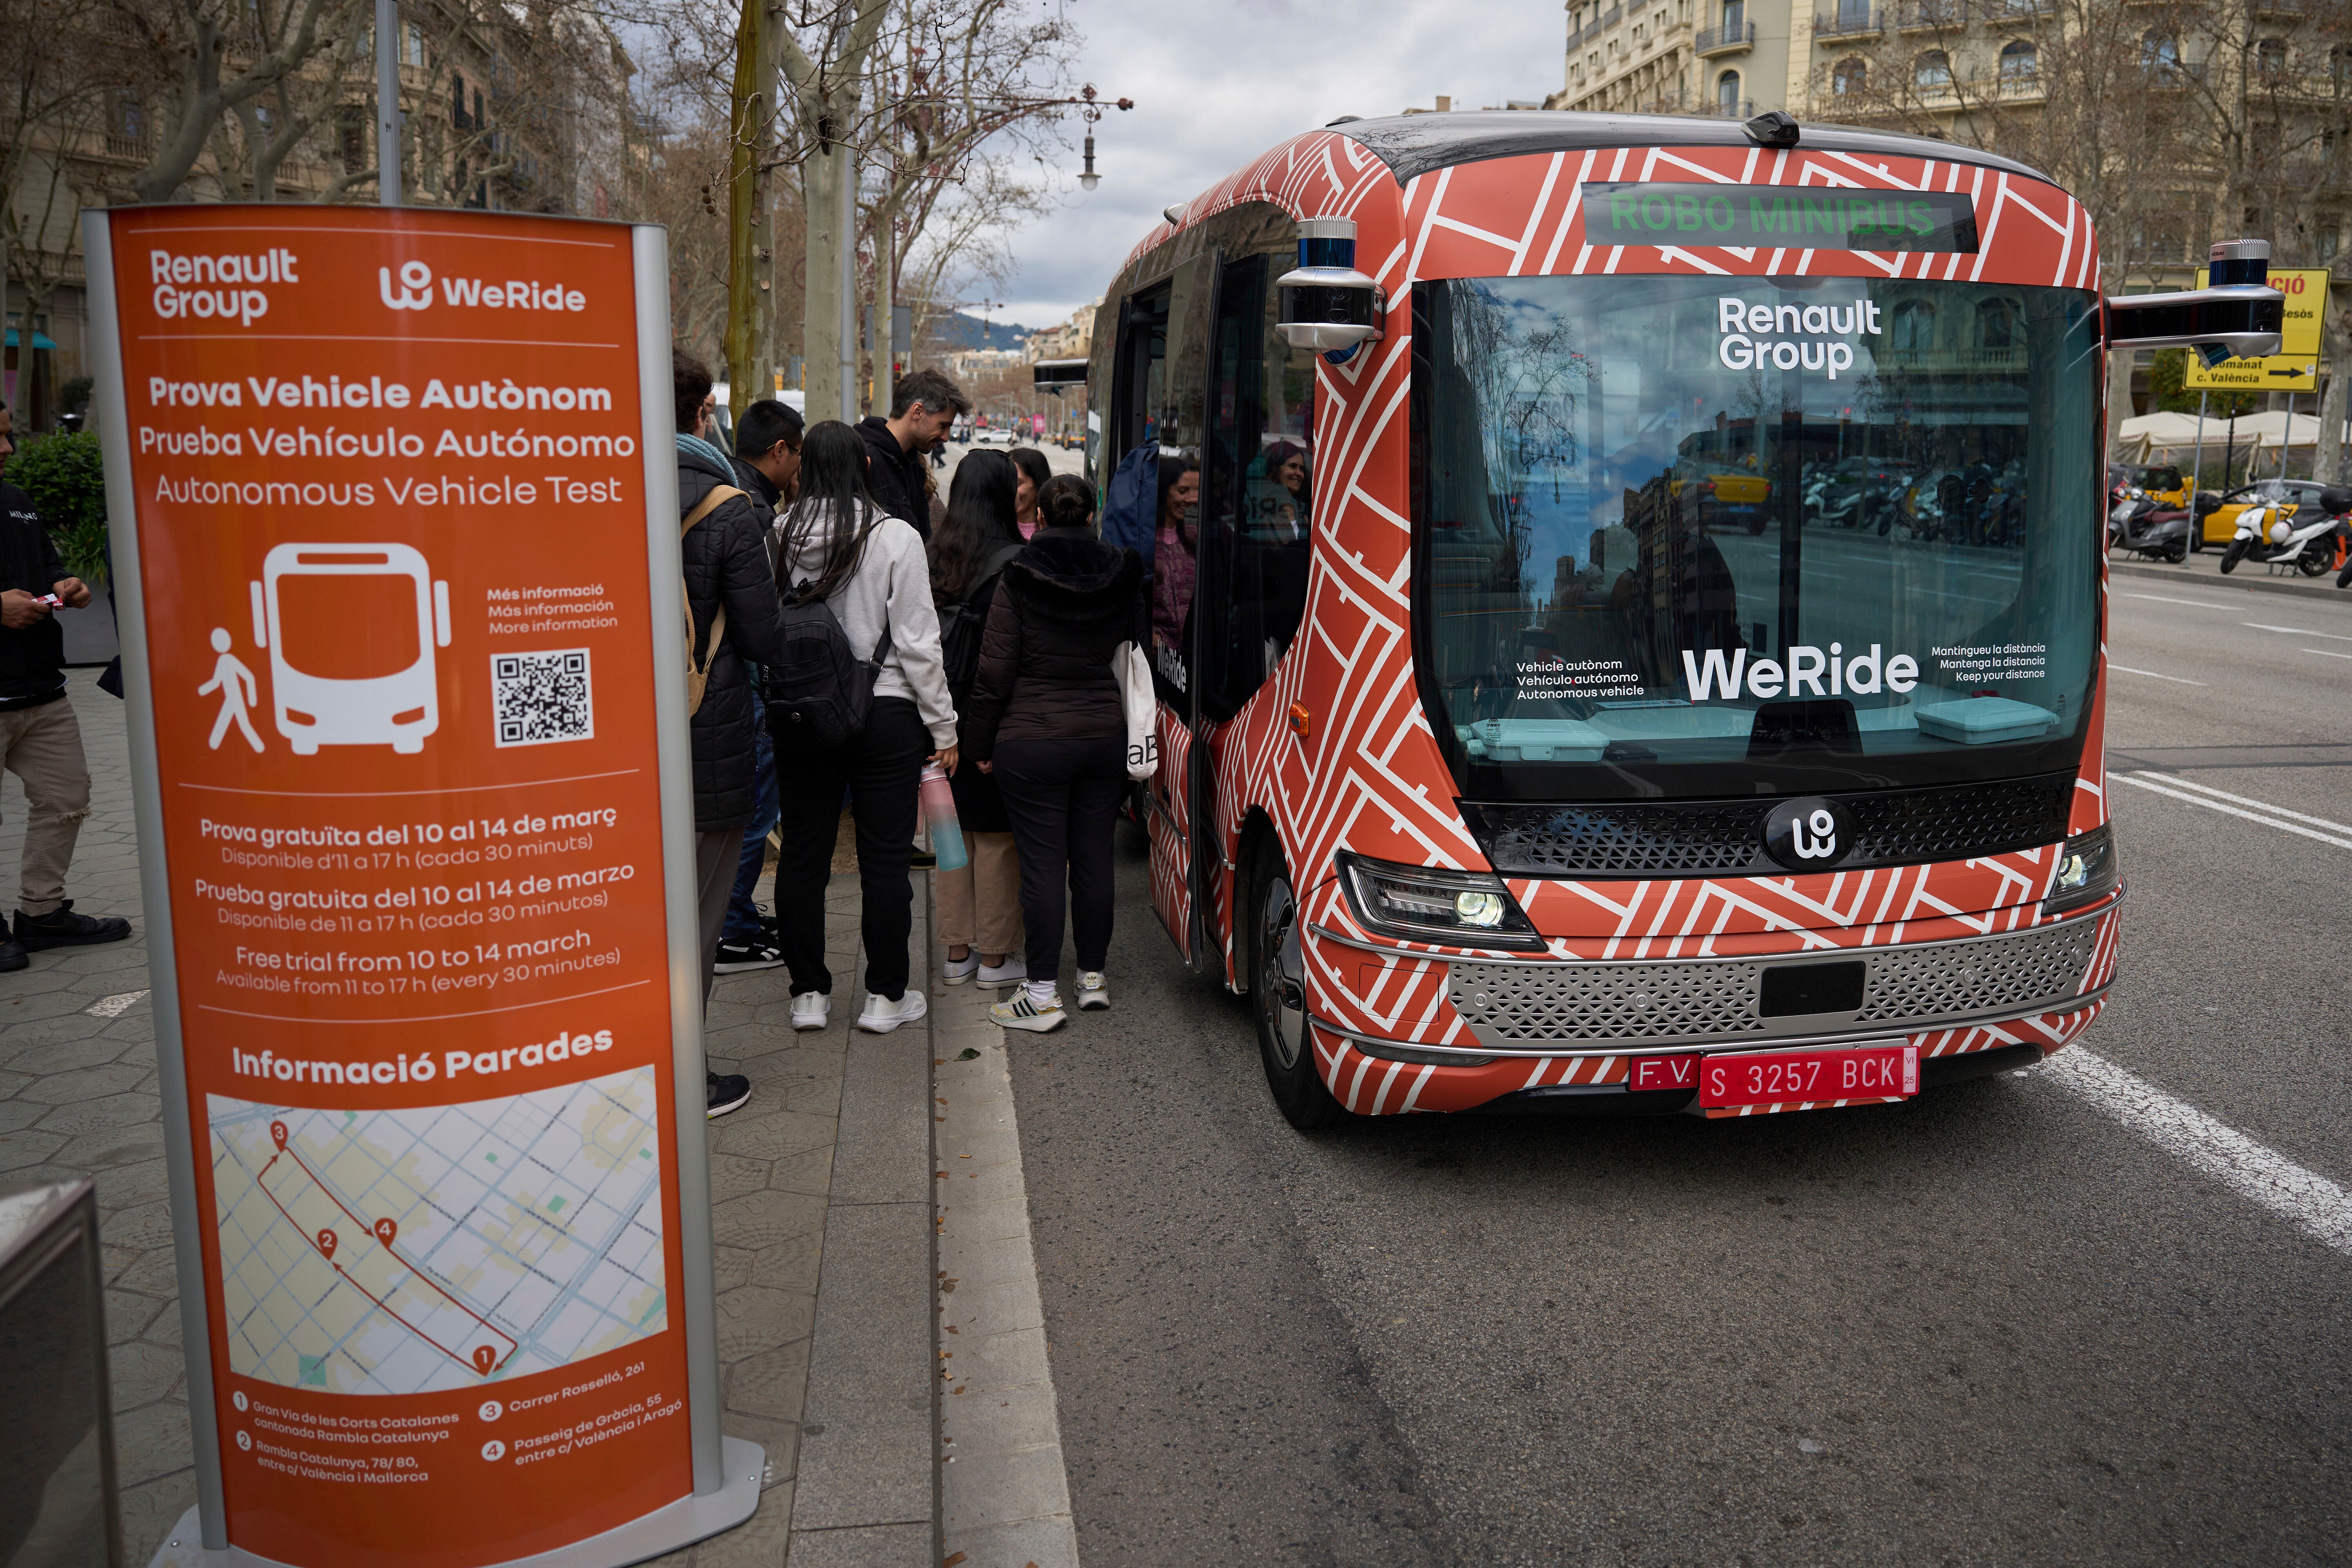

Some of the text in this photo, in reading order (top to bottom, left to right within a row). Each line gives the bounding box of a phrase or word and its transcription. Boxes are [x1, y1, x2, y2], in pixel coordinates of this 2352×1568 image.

[1610, 193, 1935, 236] ROBO MINIBUS
[151, 249, 298, 283] Renault
[441, 278, 586, 311] WeRide
[2265, 274, 2305, 295] CIÓ
[154, 287, 268, 327] Group
[1719, 298, 1881, 334] Renault
[1720, 334, 1853, 379] Group
[150, 376, 611, 410] Prova Vehicle Autònom
[2211, 373, 2259, 383] València
[140, 426, 634, 457] Prueba Vehículo Autónomo
[156, 475, 622, 506] Autonomous Vehicle Test
[487, 584, 604, 601] Més informació
[488, 600, 613, 617] Más información
[490, 617, 617, 633] More information
[1932, 643, 2045, 657] Mantingueu la distància
[1940, 656, 2045, 670] Mantenga la distancia
[1158, 639, 1186, 693] WeRide
[1517, 660, 1622, 672] Vehicle autònom
[1517, 673, 1638, 686] Vehículo autónomo
[1682, 642, 1920, 701] WeRide
[1956, 670, 2045, 682] Keep your distance
[1517, 685, 1644, 699] Autonomous vehicle
[201, 808, 616, 848] Prova gratuïta del 10 al 14 de març
[222, 833, 592, 869] Disponible d'11 a 17 h (cada 30 minuts)
[196, 865, 634, 911] Prueba gratuita del 10 al 14 de marzo
[218, 889, 608, 932] Disponible de 11 a 17 h (cada 30 minutos)
[237, 929, 590, 972] Free trial from 10 to 14 march
[217, 947, 620, 995] Available from 11 to 17 h (every 30 minutes)
[233, 1030, 613, 1084] Informació Parades
[1711, 1058, 1895, 1096] S 3257 BCK
[275, 1125, 284, 1139] 3
[323, 1233, 332, 1247] 2
[379, 1222, 391, 1235] 4
[481, 1350, 487, 1363] 1
[510, 1361, 644, 1411] Carrer Rosselló, 261
[253, 1401, 459, 1428] Gran Via de les Corts Catalanes
[485, 1405, 496, 1417] 3
[515, 1394, 661, 1451] Passeig de Gràcia, 55
[240, 1434, 248, 1448] 2
[255, 1417, 449, 1443] cantonada Rambla Catalunya
[515, 1399, 682, 1465] entre c/ València i Aragó
[256, 1440, 298, 1461] Rambla
[299, 1452, 369, 1469] Catalunya,
[396, 1457, 418, 1468] 80,
[487, 1445, 499, 1457] 4
[258, 1457, 428, 1483] entre c/ València i Mallorca
